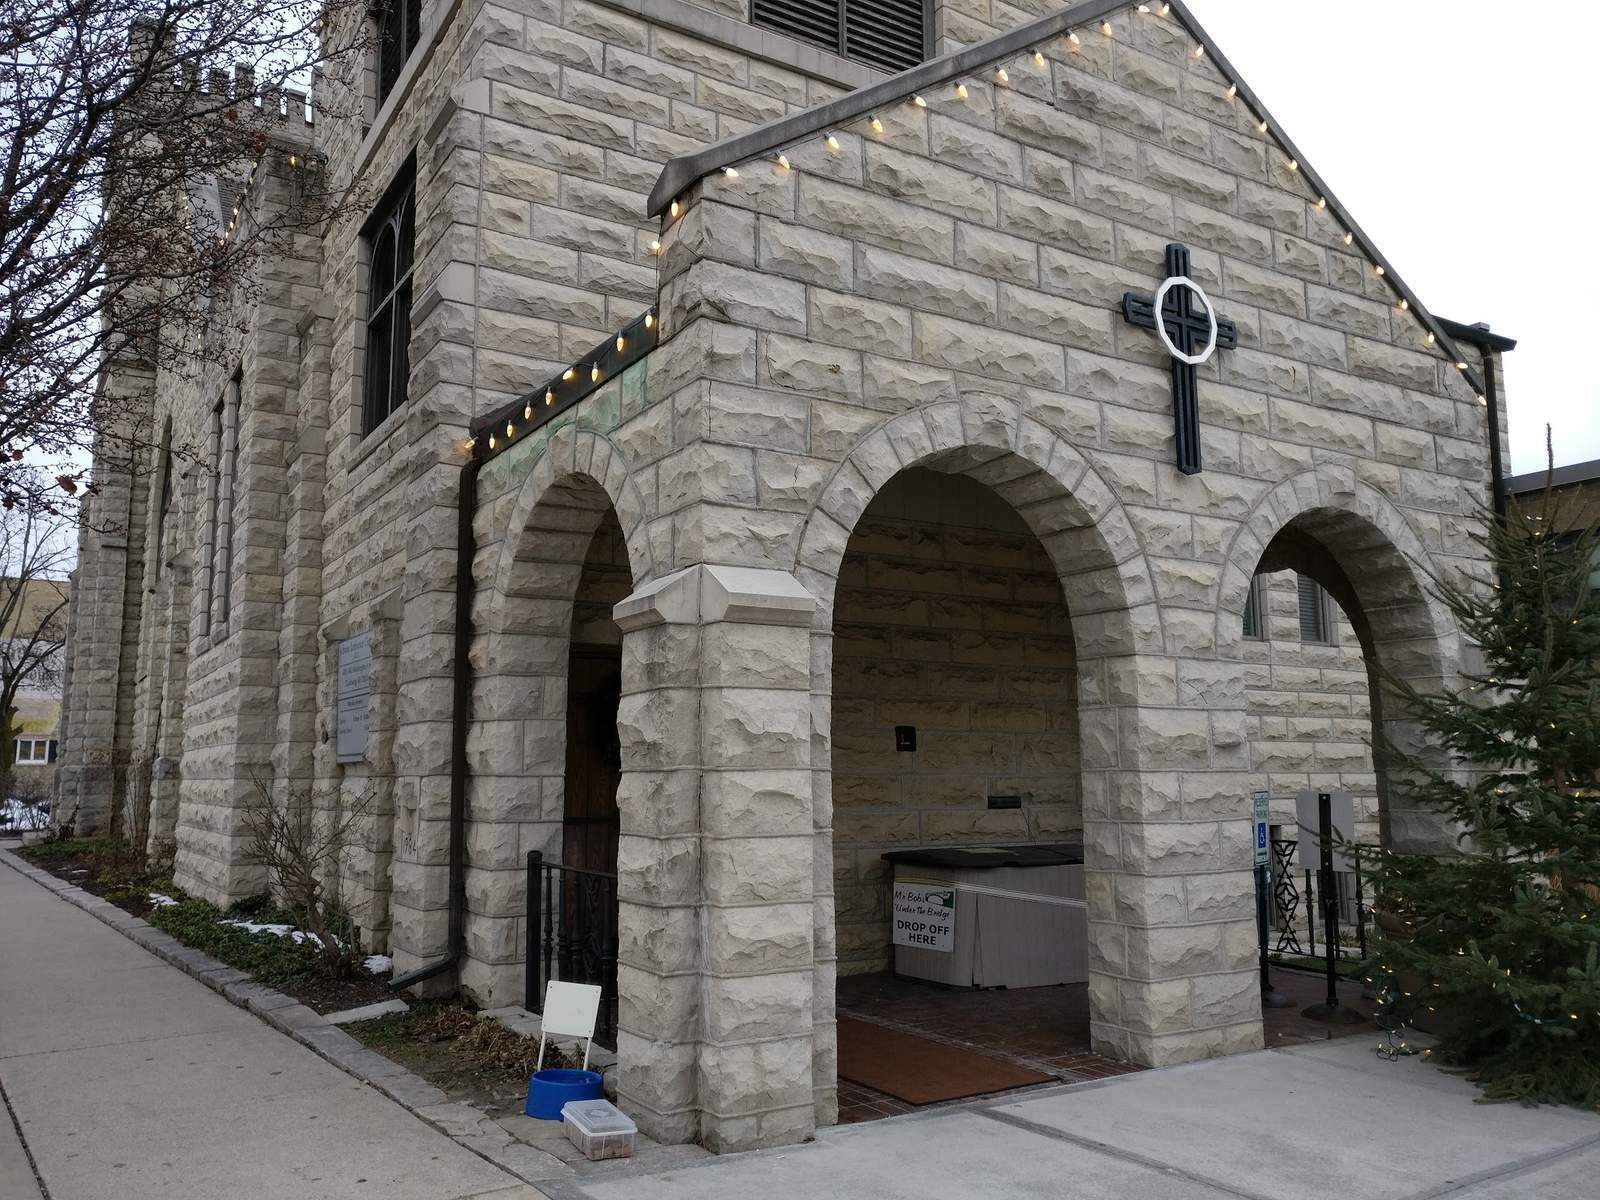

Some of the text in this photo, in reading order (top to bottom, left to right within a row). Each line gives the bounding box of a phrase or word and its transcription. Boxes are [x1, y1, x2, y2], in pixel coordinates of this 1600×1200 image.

[895, 904, 950, 921] Under The Bridge
[897, 920, 950, 936] DROP OFF
[909, 933, 937, 946] HERE
